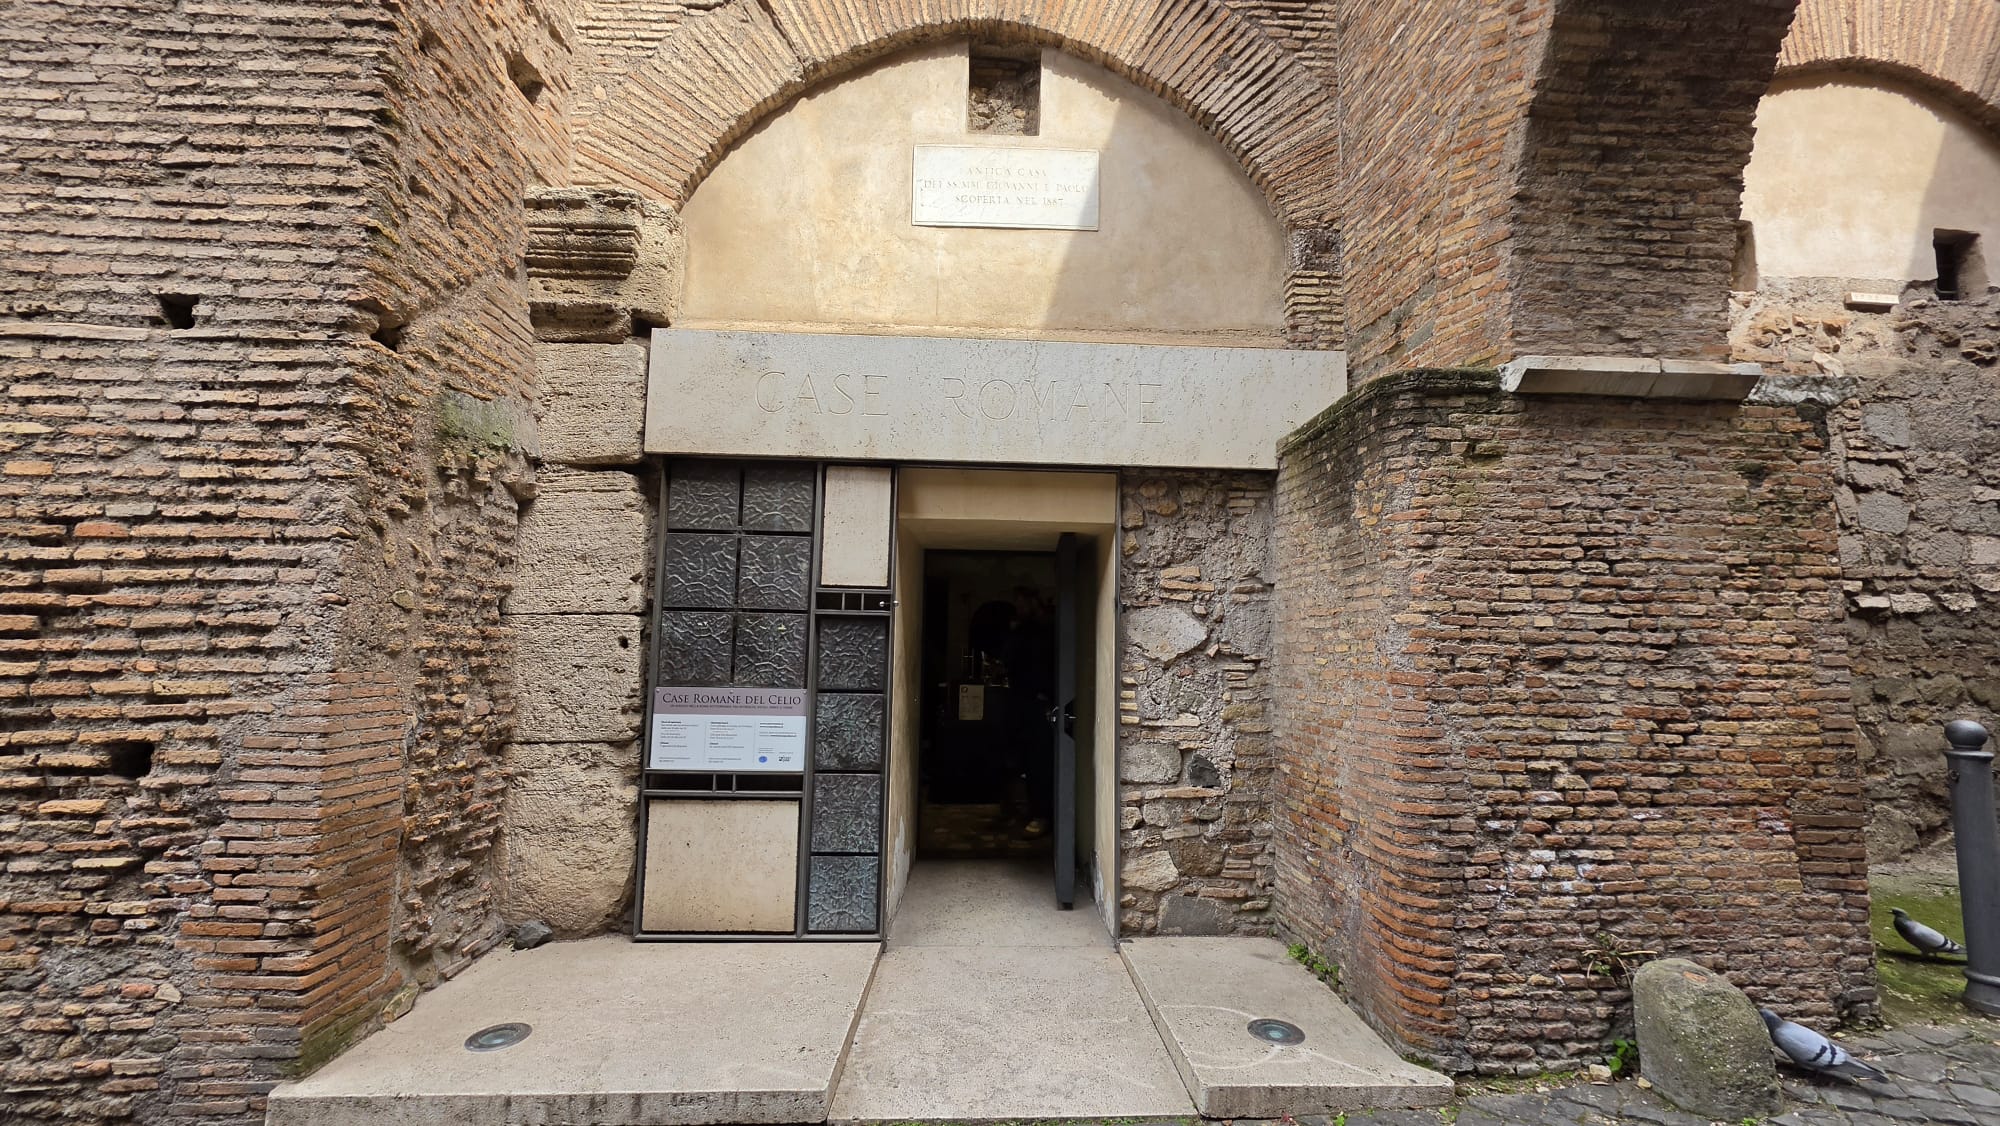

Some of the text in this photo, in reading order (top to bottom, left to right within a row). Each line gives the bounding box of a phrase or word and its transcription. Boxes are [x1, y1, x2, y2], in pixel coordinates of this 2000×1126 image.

[967, 167, 1047, 177] ANTICA CASA
[955, 194, 1010, 205] SCOPERTA
[1016, 196, 1037, 206] NEL
[755, 371, 1164, 424] CASE ROMANE
